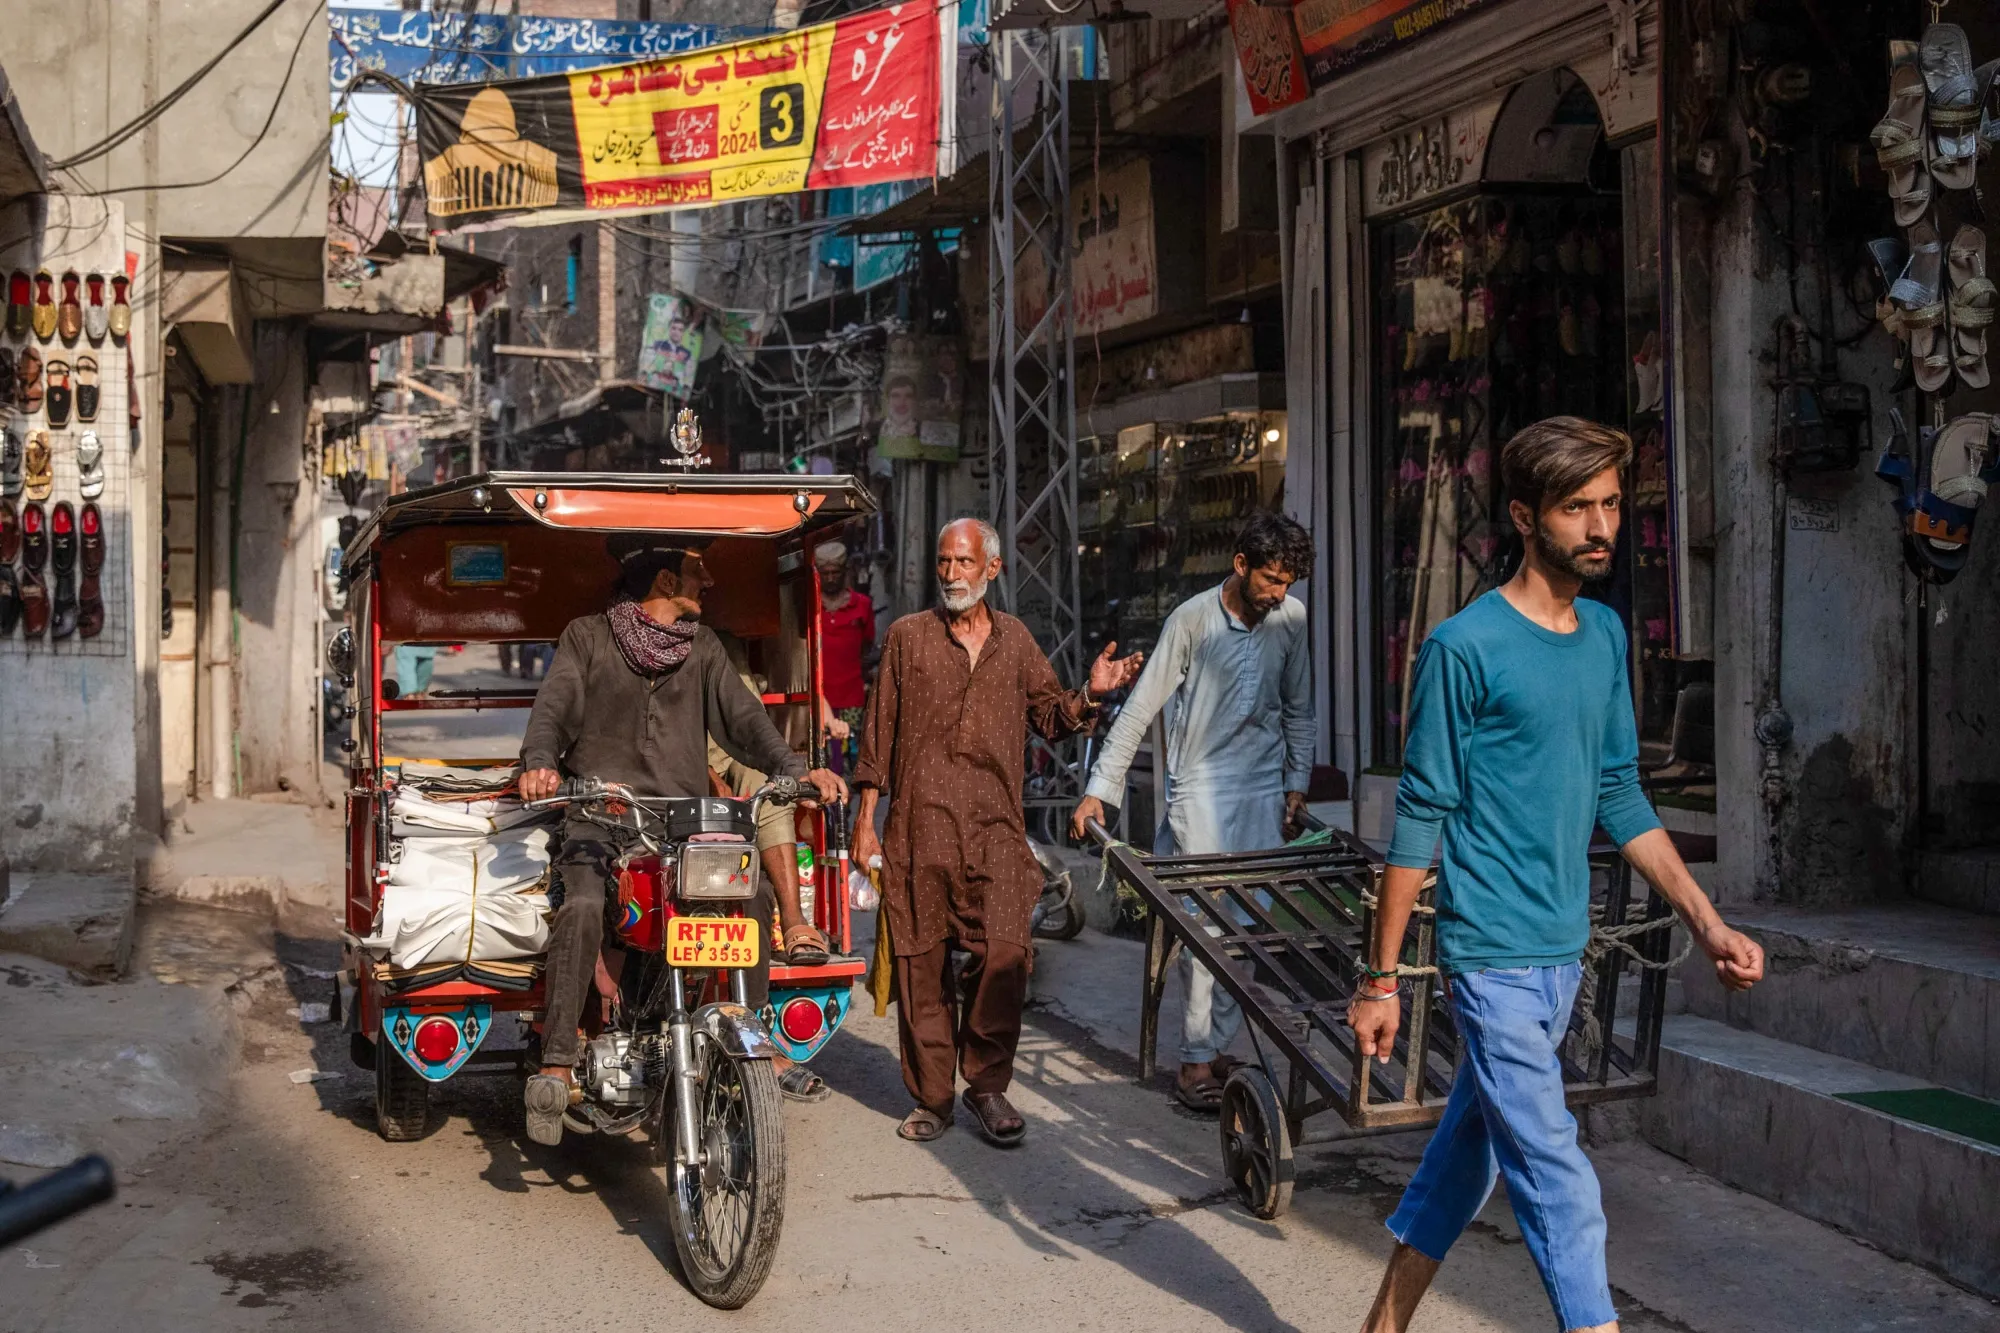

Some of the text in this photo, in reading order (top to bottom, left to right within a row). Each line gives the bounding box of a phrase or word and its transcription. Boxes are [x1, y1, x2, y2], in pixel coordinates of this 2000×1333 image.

[684, 31, 809, 96] احتجاجی
[852, 6, 904, 96] غزہ
[729, 91, 794, 142] 3 مئی
[901, 94, 918, 119] کے
[826, 117, 843, 131] سے
[592, 129, 617, 164] خان
[685, 138, 694, 158] 2
[694, 139, 710, 158] دن
[720, 131, 757, 156] 2024
[843, 140, 863, 168] کے
[884, 136, 913, 166] اظہار
[678, 923, 747, 941] RFTW
[673, 947, 752, 962] LEY 3553
